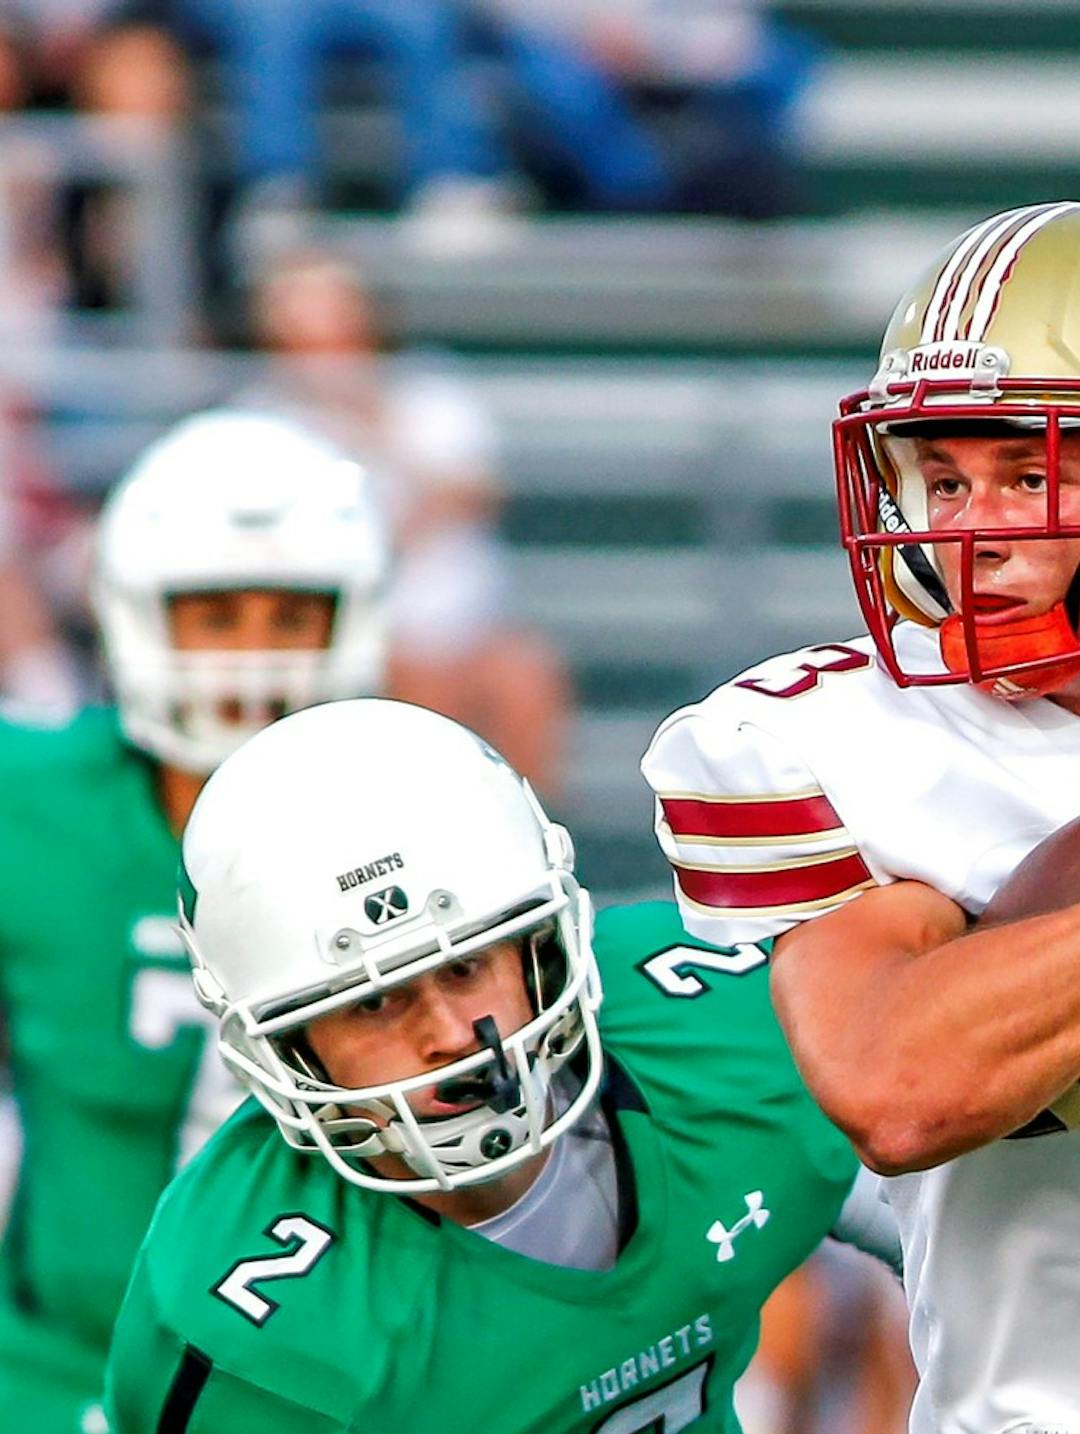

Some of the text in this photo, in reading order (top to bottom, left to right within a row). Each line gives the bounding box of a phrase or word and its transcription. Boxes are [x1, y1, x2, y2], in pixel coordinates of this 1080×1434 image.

[911, 348, 979, 372] Riddell
[732, 643, 874, 700] 3
[336, 852, 404, 892] HORNETS
[211, 1211, 336, 1328] 2
[579, 1313, 713, 1412] HORNETS
